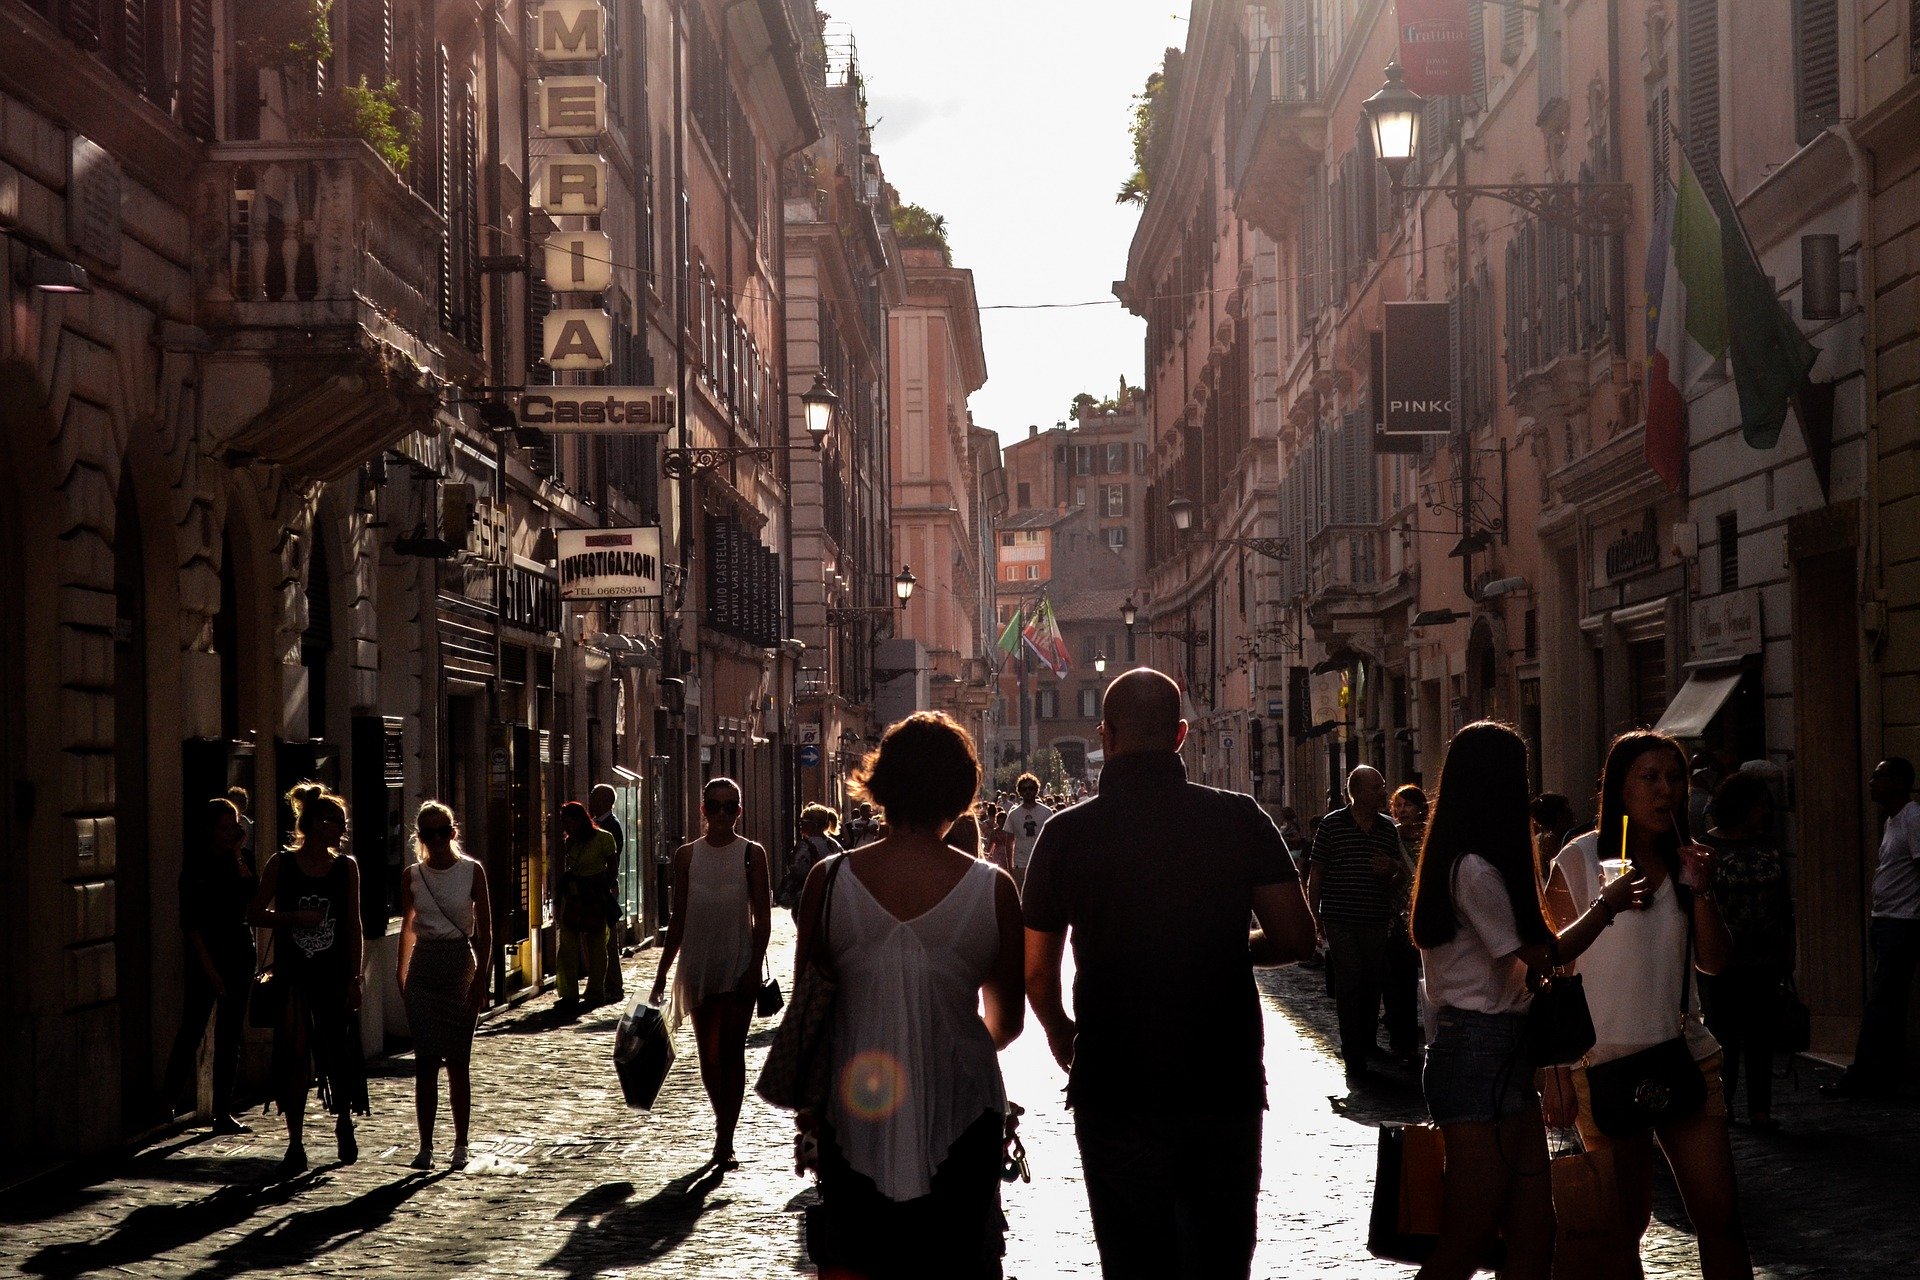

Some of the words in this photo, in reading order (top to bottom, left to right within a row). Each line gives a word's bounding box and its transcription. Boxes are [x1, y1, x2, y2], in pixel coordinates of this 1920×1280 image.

[520, 395, 675, 424] Castelli
[561, 551, 655, 585] INVESTIGAZIONI
[716, 522, 728, 584] CASTELLANI
[575, 588, 595, 596] TEL.
[597, 586, 646, 595] 066789341
[716, 588, 728, 623] FLAVIO
